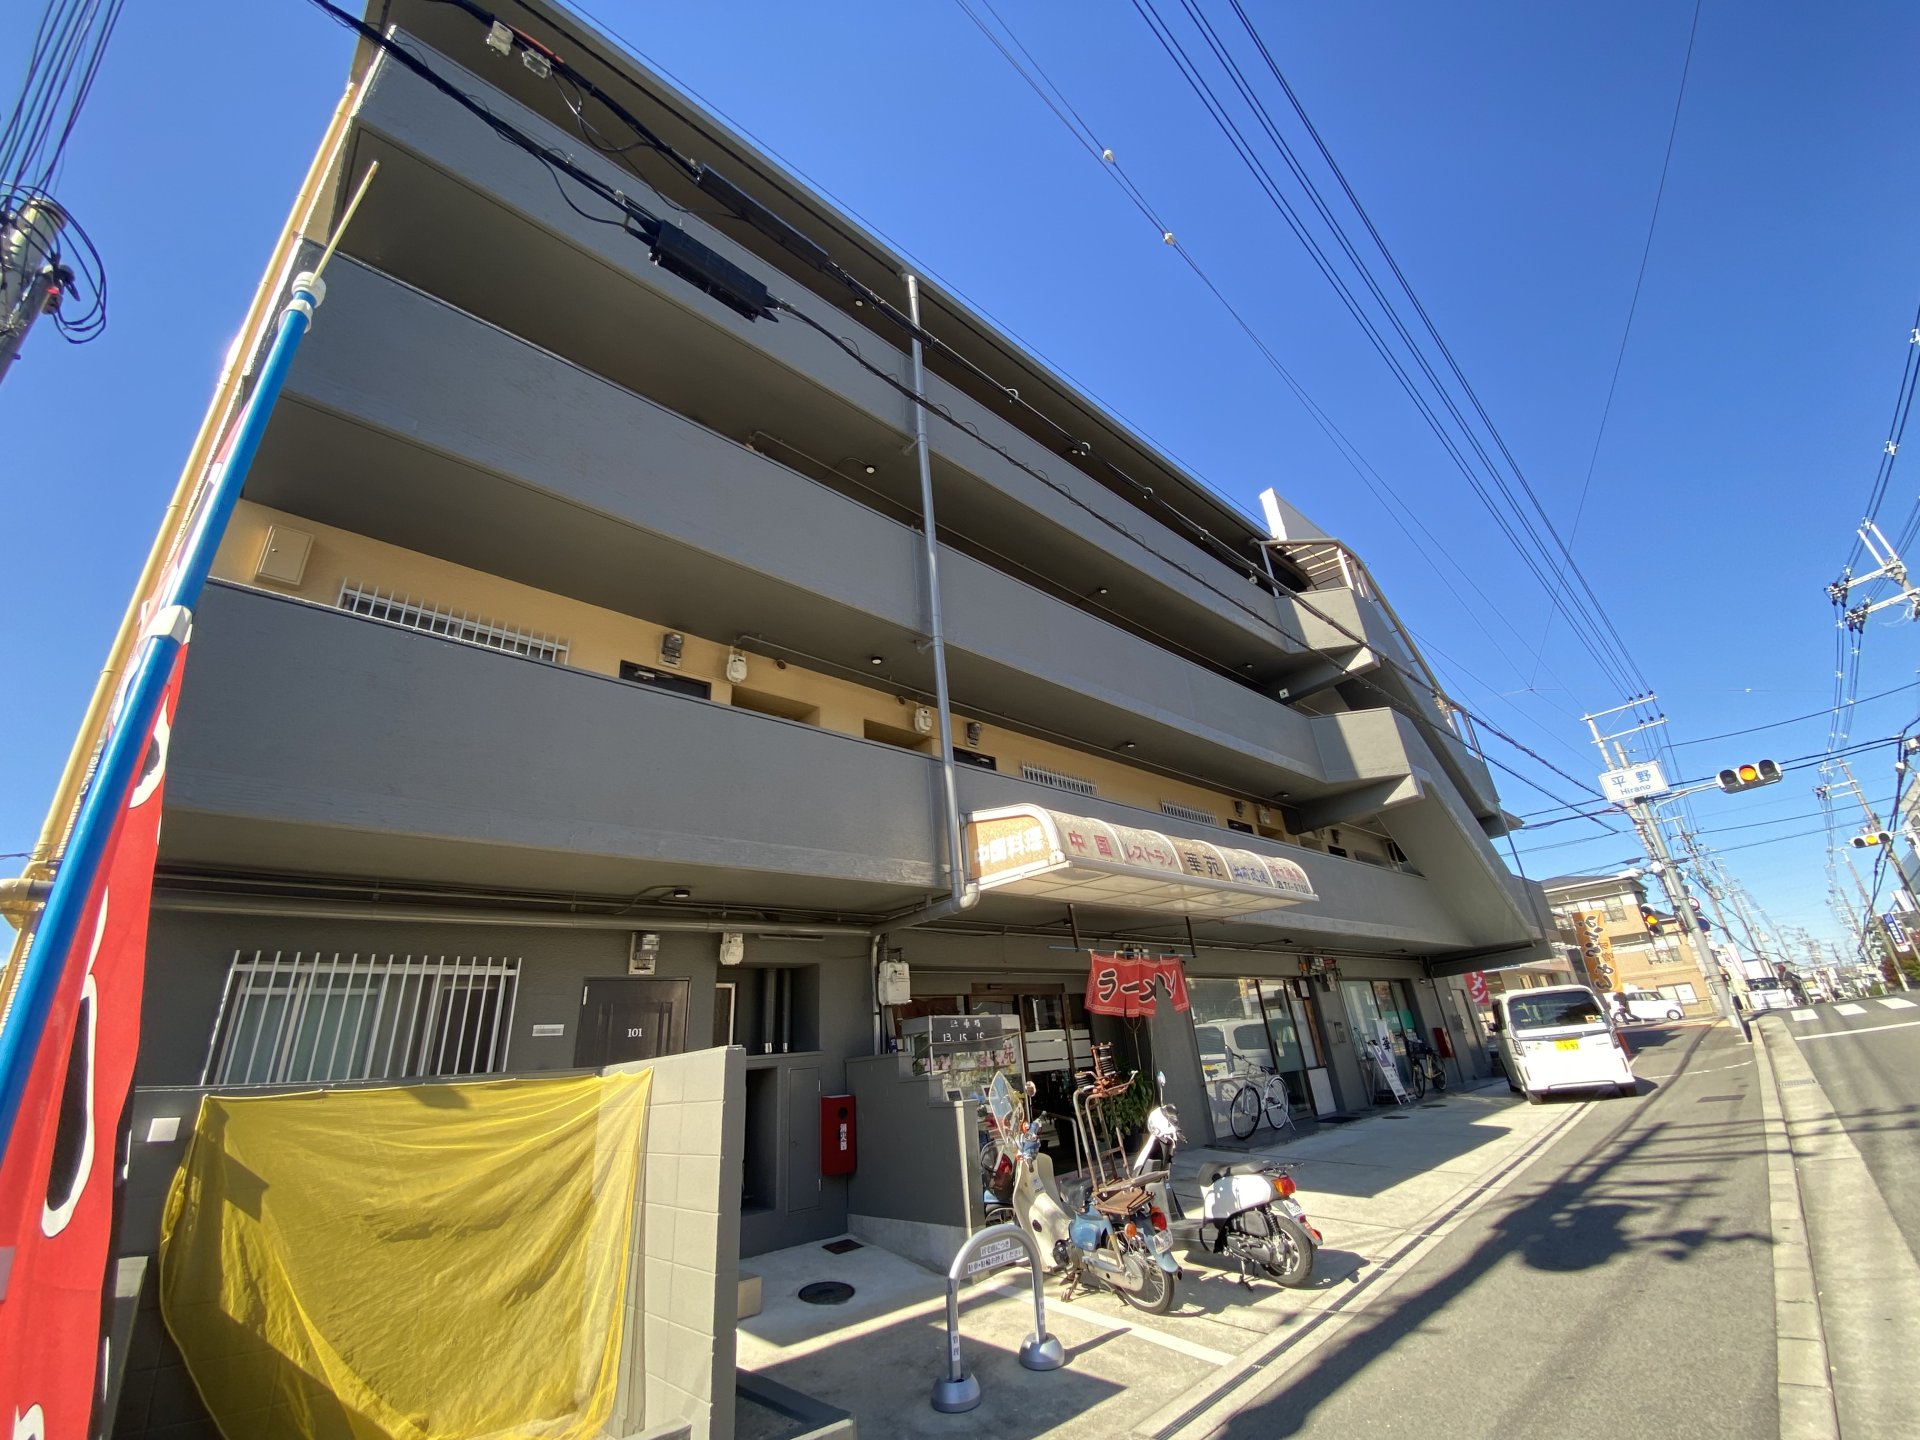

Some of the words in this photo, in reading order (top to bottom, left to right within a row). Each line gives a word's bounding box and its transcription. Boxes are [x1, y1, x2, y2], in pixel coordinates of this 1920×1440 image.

[1610, 769, 1652, 788] 平野
[1620, 784, 1651, 796] Hirano
[1068, 830, 1113, 857] 中国
[1183, 850, 1224, 877] 華苑
[627, 1028, 643, 1038] 101
[840, 1123, 848, 1151] 消火器
